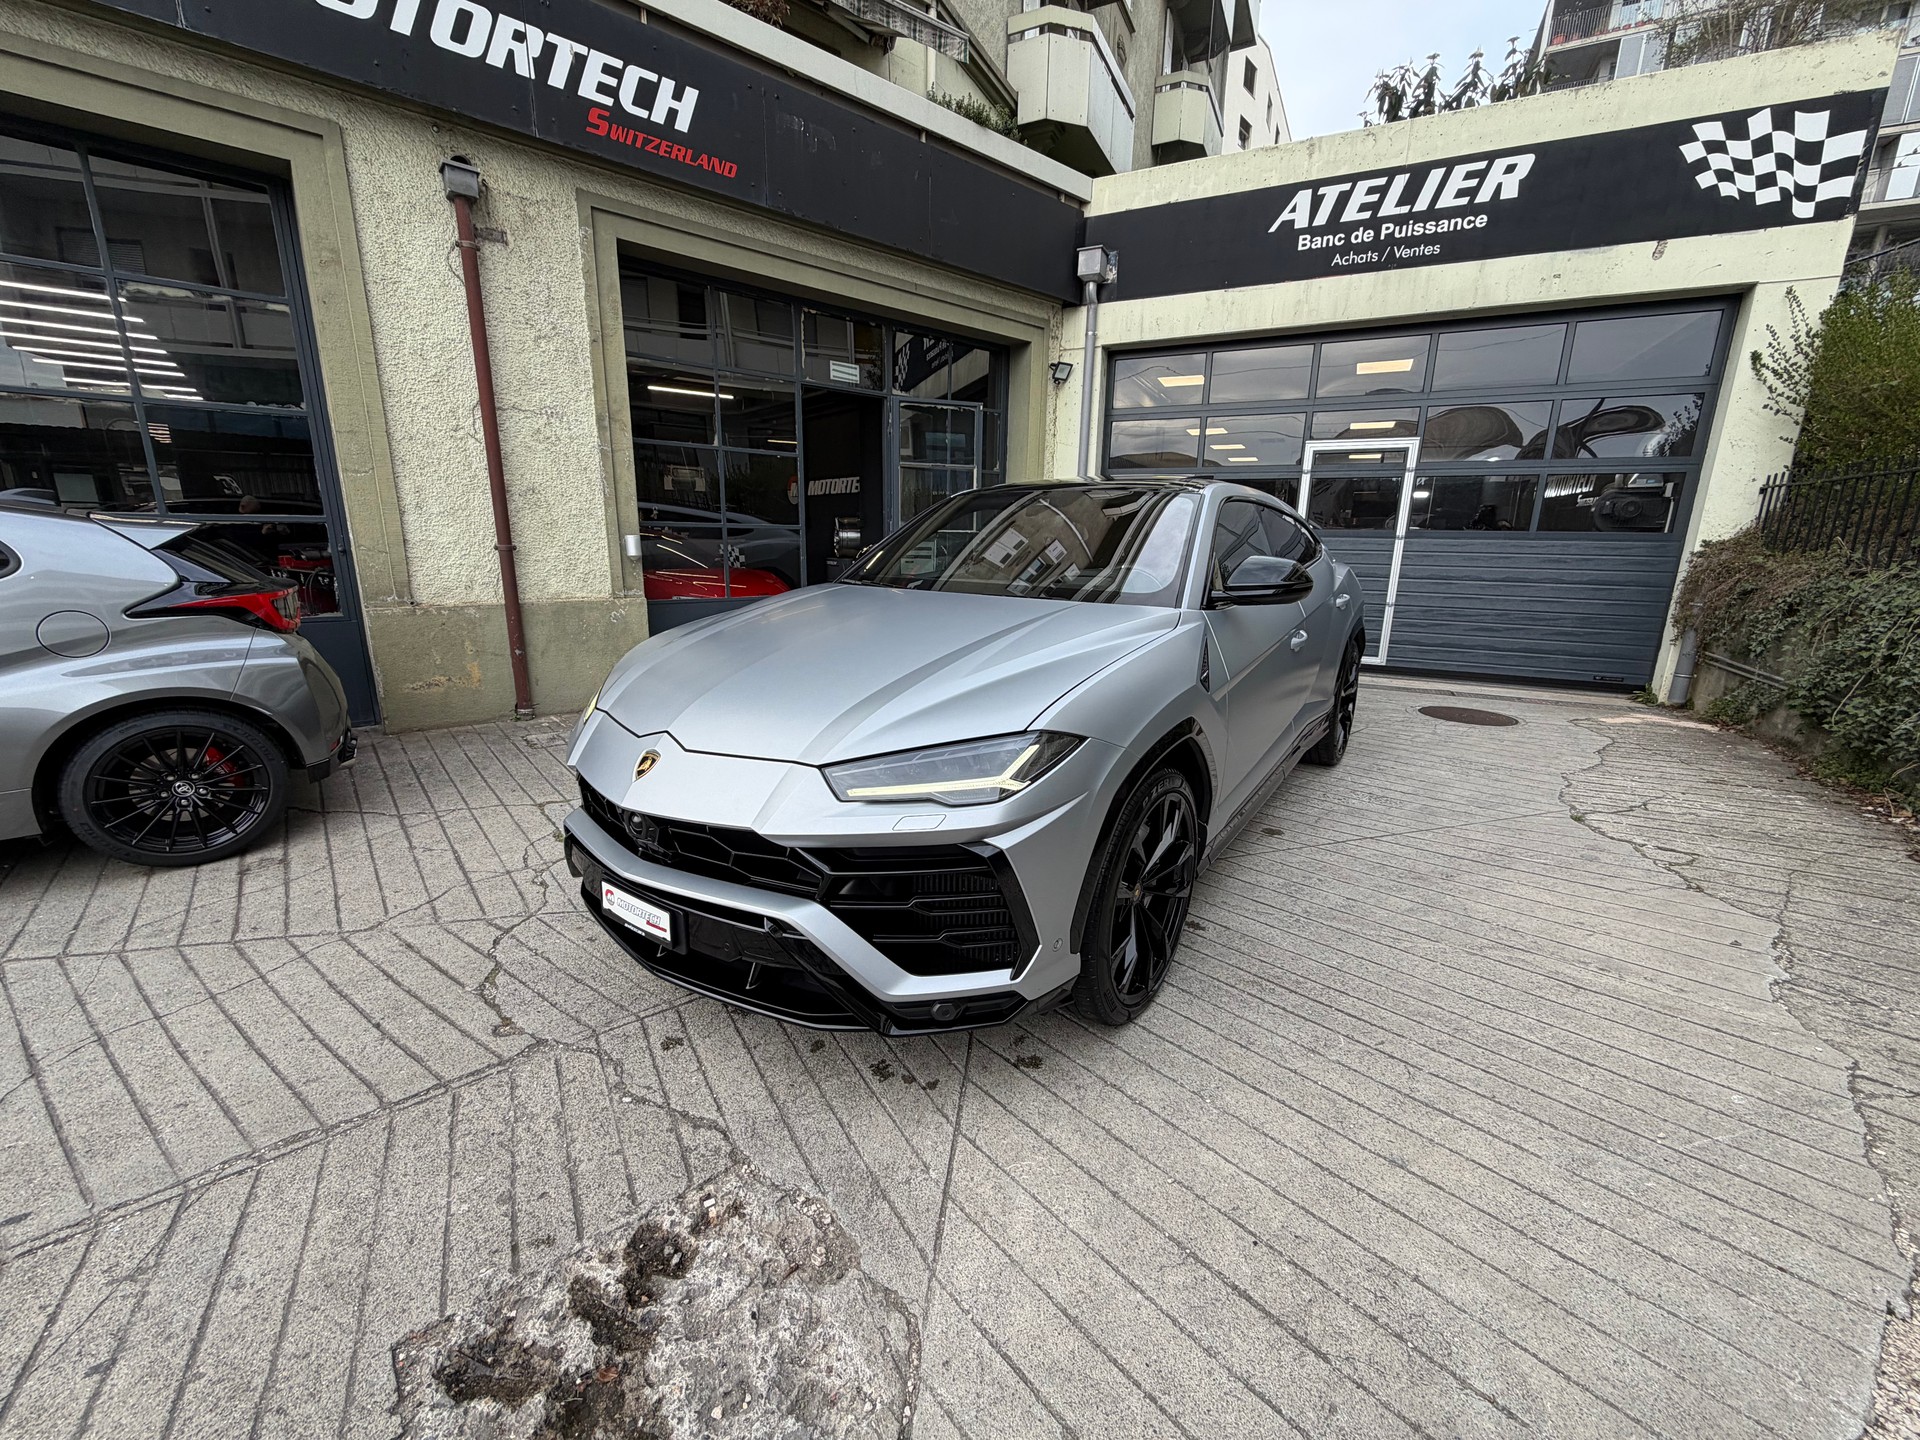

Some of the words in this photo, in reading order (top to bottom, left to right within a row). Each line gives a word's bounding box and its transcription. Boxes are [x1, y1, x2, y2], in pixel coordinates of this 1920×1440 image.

[1267, 153, 1536, 233] ATELIER
[1297, 233, 1346, 251] Banc
[1350, 226, 1375, 244] de
[1379, 214, 1489, 241] Puissance
[1330, 250, 1379, 267] Achats
[1393, 243, 1441, 259] Ventes
